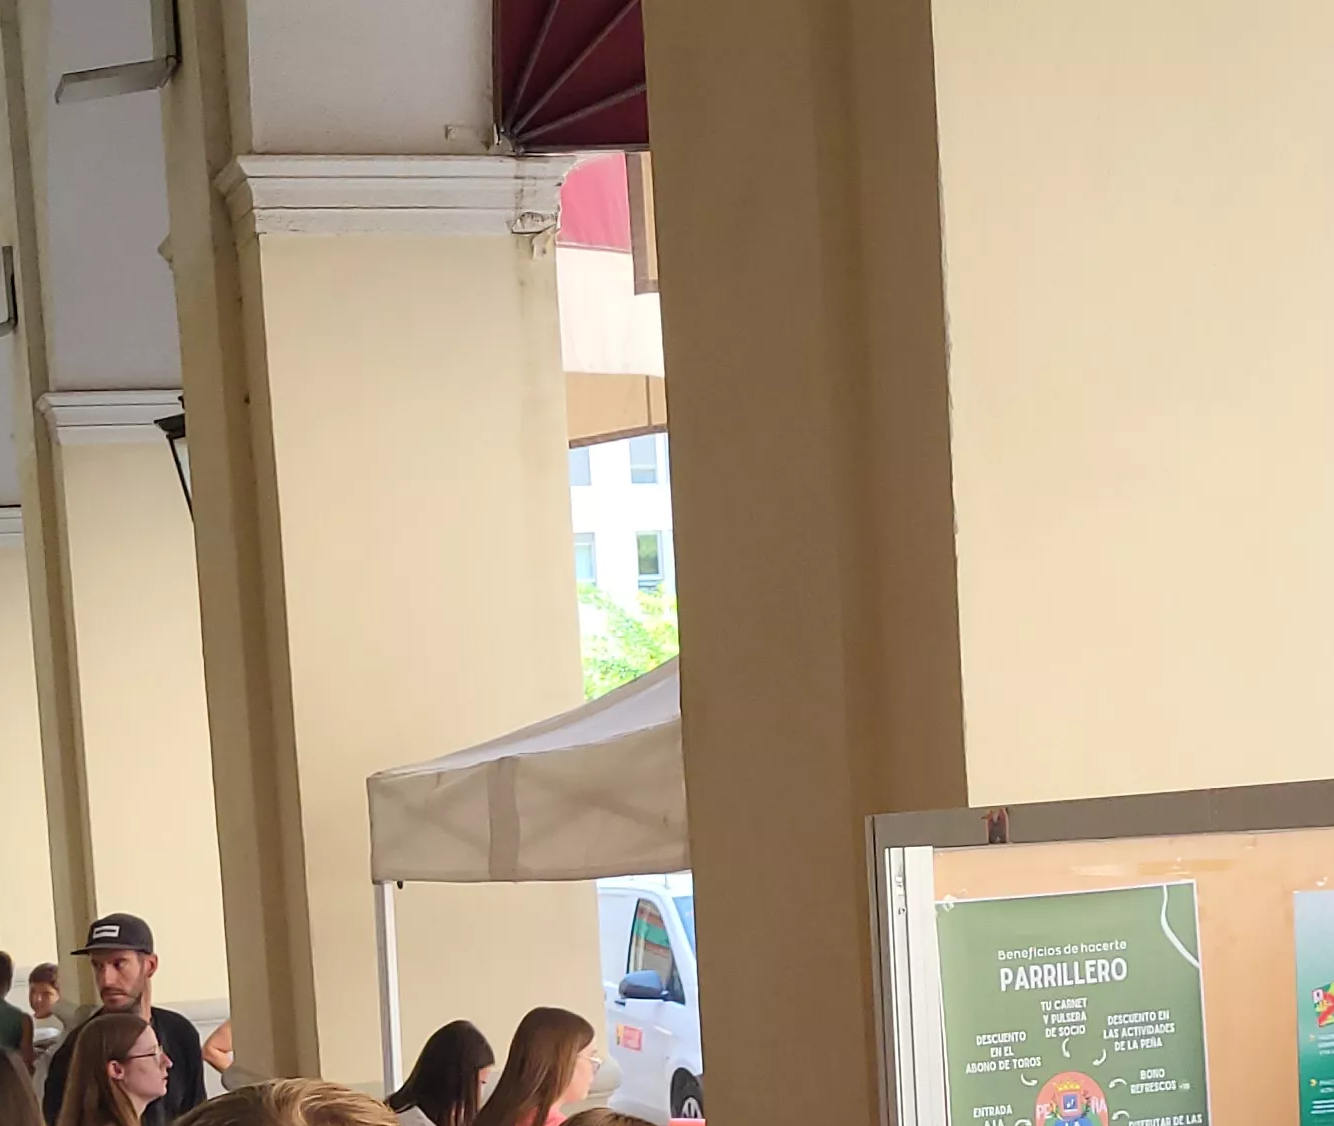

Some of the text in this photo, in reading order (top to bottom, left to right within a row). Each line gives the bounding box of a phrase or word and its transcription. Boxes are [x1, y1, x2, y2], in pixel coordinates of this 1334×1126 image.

[998, 939, 1128, 961] Beneficios de hacerte
[1000, 957, 1128, 992] PARRILLERO
[1040, 998, 1088, 1012] TU CARNET
[1043, 1011, 1087, 1025] Y PULSERA
[1107, 1010, 1170, 1026] DESCUENTO EN
[976, 1031, 1027, 1046] DESCUENTO
[1045, 1025, 1086, 1038] DE SOCIO
[1103, 1023, 1175, 1040] LAS ACTIVIDADES
[1114, 1036, 1163, 1052] DE LA PEÑA
[990, 1046, 1014, 1058] EN EL
[965, 1056, 1042, 1074] ABONO DE TOROS
[1140, 1068, 1165, 1080] BONO
[1130, 1080, 1177, 1095] REFRESCOS
[973, 1104, 1013, 1118] ENTRADA
[1173, 1115, 1184, 1126] DE
[1186, 1113, 1203, 1125] LAS
